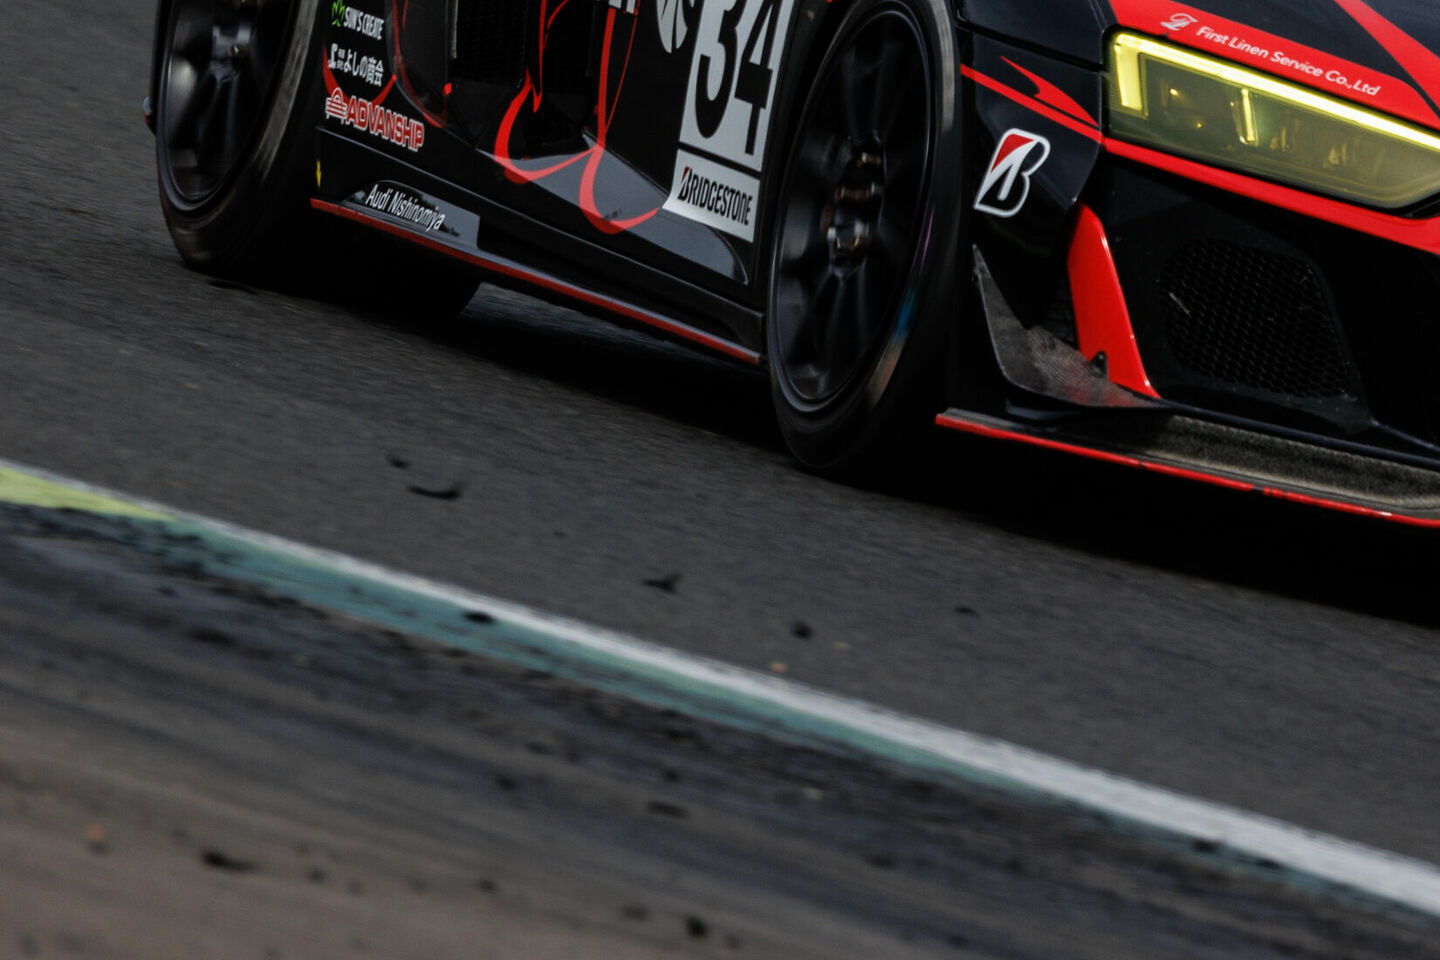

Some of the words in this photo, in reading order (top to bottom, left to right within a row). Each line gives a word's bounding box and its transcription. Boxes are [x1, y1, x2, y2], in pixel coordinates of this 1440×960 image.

[1196, 26, 1228, 45] First
[1228, 36, 1268, 59] Linen
[1270, 51, 1324, 78] Service
[346, 95, 426, 153] ADVANSHIP
[365, 184, 394, 211] Audi
[387, 190, 446, 233] Nishinomiya
[677, 166, 753, 226] BRIDGESTONE
